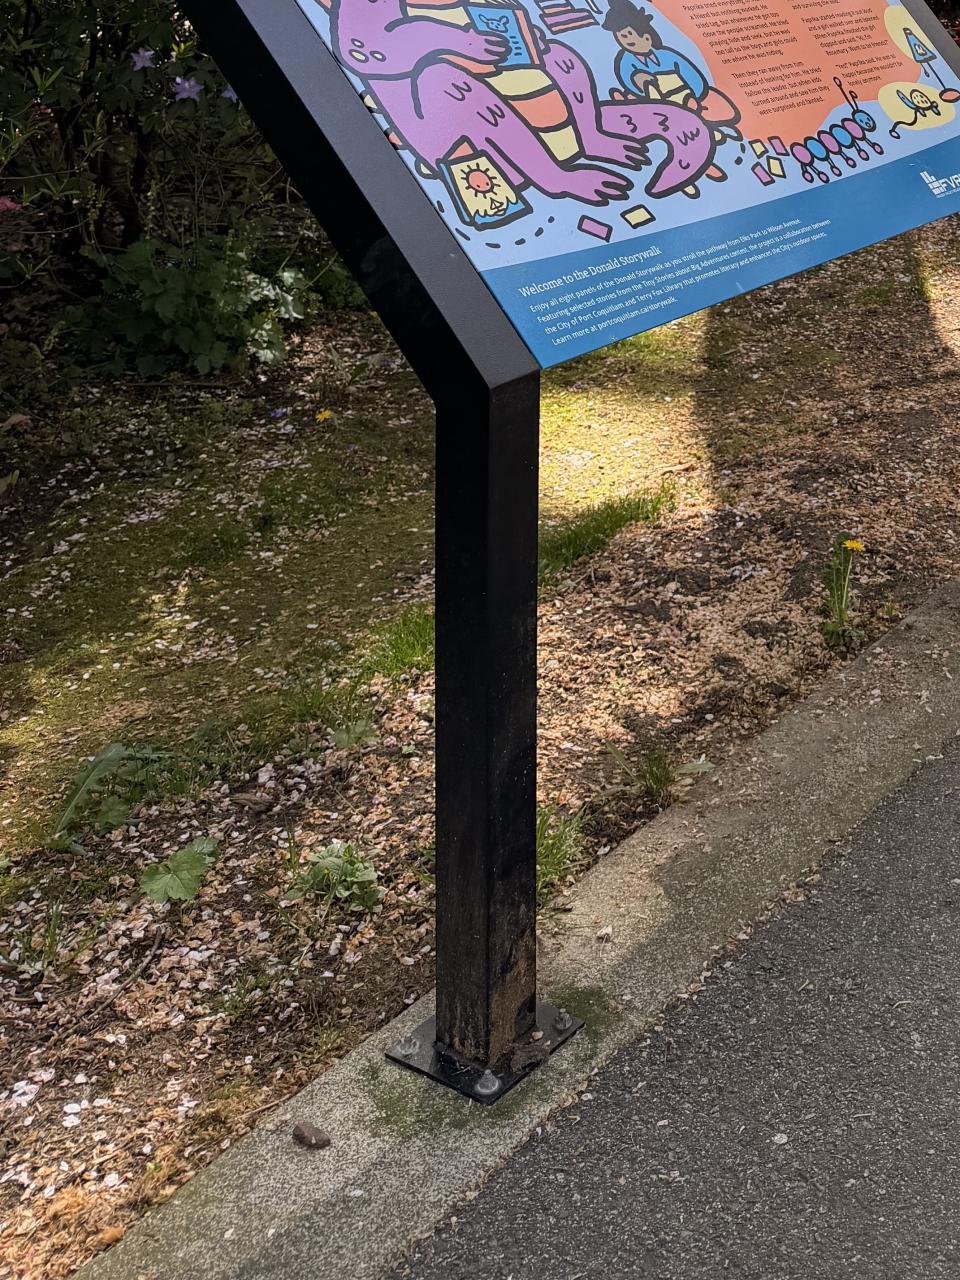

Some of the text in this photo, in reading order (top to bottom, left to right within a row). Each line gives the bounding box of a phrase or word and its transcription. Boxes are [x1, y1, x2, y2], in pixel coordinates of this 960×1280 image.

[519, 279, 563, 296] Welcome
[573, 270, 590, 280] the
[588, 258, 620, 275] Donald
[619, 246, 662, 265] Storywalk
[530, 303, 549, 312] Enjoy
[559, 293, 575, 303] eight
[576, 287, 596, 298] panels
[614, 272, 636, 284] Donald
[636, 264, 664, 277] Storywalk
[671, 259, 682, 267] you
[682, 253, 696, 261] stroll
[706, 244, 728, 254] pathway
[537, 309, 570, 322] Featuring
[570, 299, 595, 312] selected
[596, 293, 617, 303] stories
[616, 288, 632, 296] from
[654, 273, 675, 282] Stories
[675, 267, 691, 276] about
[700, 255, 729, 267] Adventures
[758, 239, 775, 249] project
[783, 226, 812, 239] collaboration
[571, 317, 578, 325] of
[578, 314, 593, 322] Port
[592, 303, 624, 317] Coquitlam
[625, 298, 636, 306] and
[663, 283, 683, 292] Library
[695, 270, 720, 282] promotes
[552, 335, 572, 345] Learn
[572, 328, 590, 338] more
